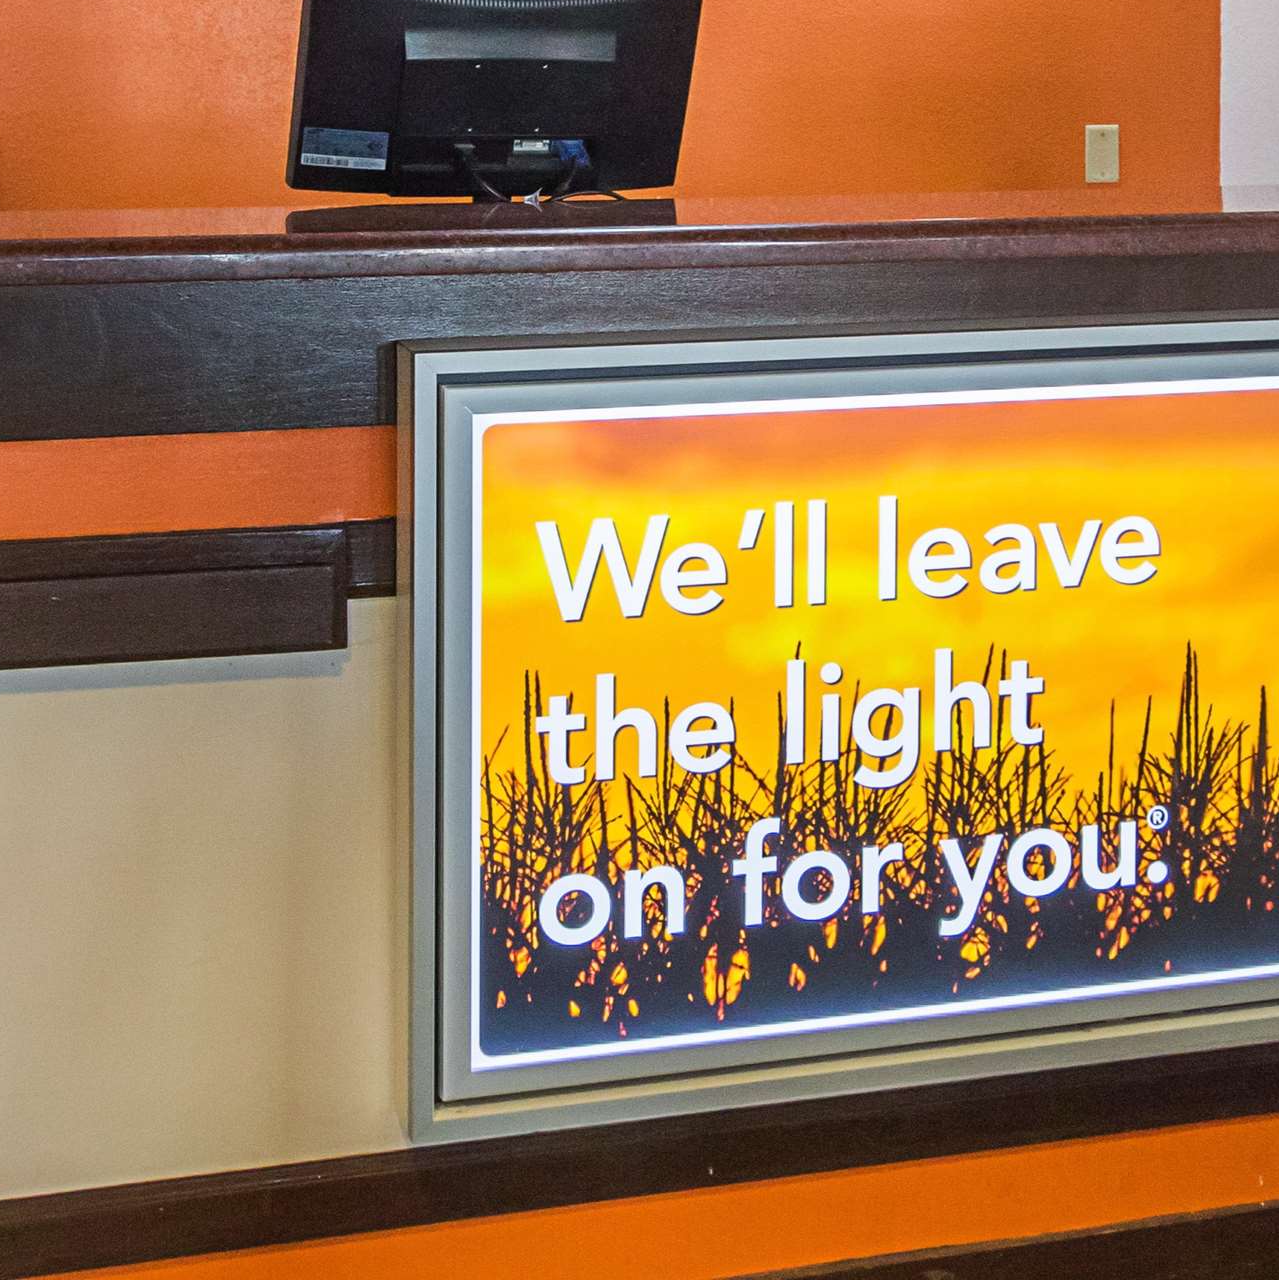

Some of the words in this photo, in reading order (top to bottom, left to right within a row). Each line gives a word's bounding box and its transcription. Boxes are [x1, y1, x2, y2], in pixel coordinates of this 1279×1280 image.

[878, 495, 1162, 601] leave
[535, 673, 736, 784] the
[785, 648, 1045, 790] light
[539, 860, 686, 947] on
[732, 817, 904, 927] for
